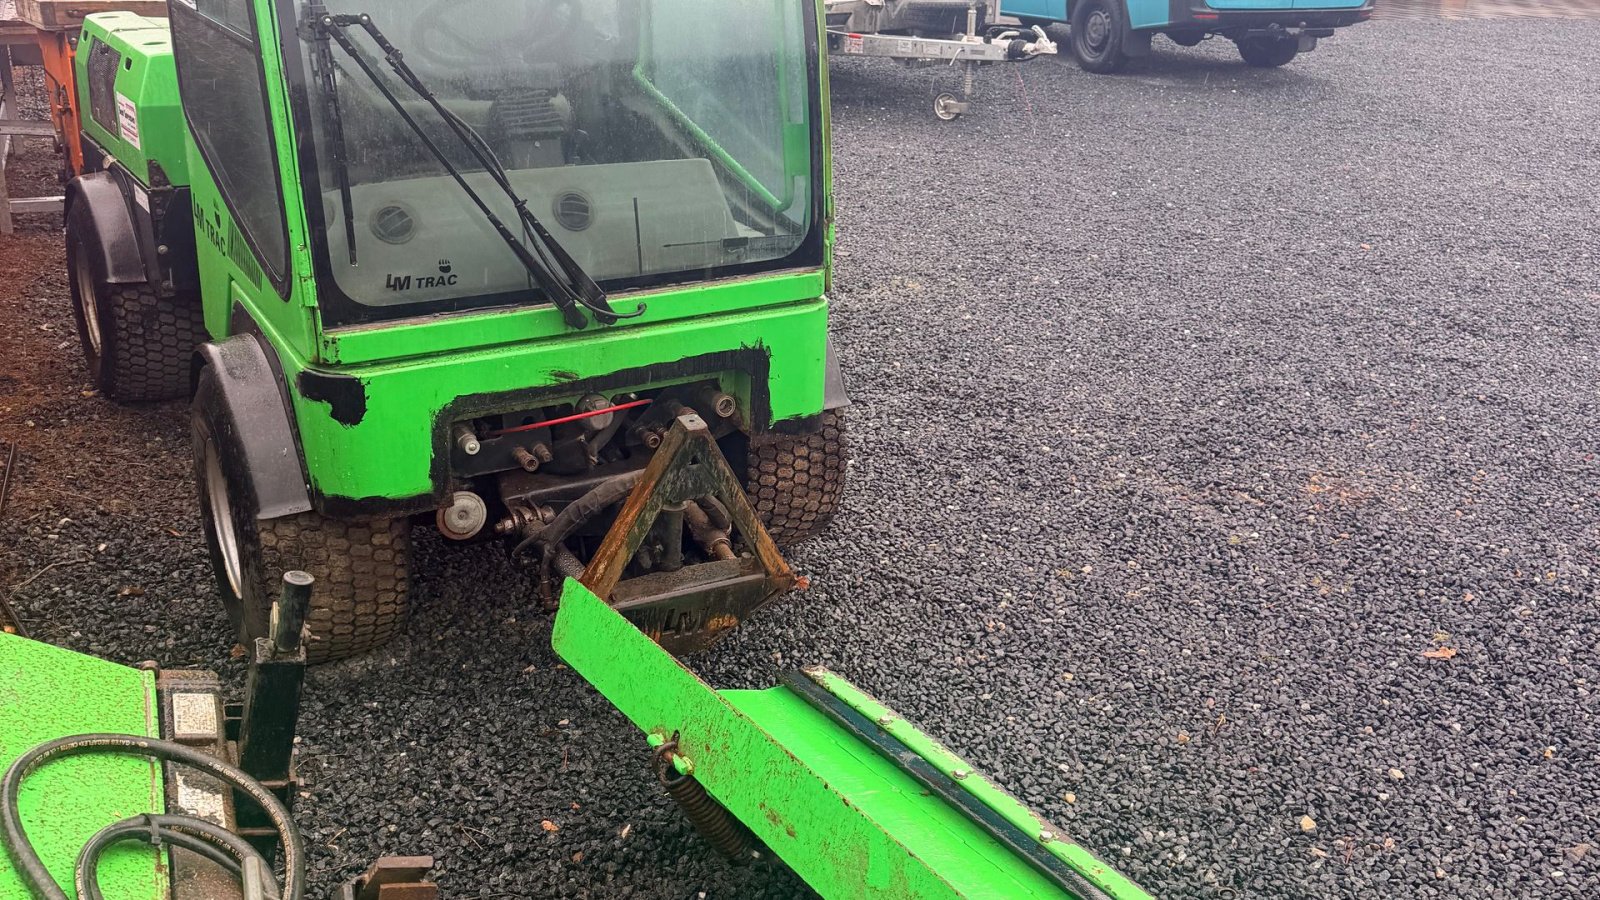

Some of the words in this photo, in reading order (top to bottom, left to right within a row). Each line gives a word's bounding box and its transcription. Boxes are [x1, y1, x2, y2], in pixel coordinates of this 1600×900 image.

[193, 192, 205, 233] LM
[205, 218, 226, 257] TRAC
[386, 273, 411, 291] LM
[416, 274, 458, 289] TRAC
